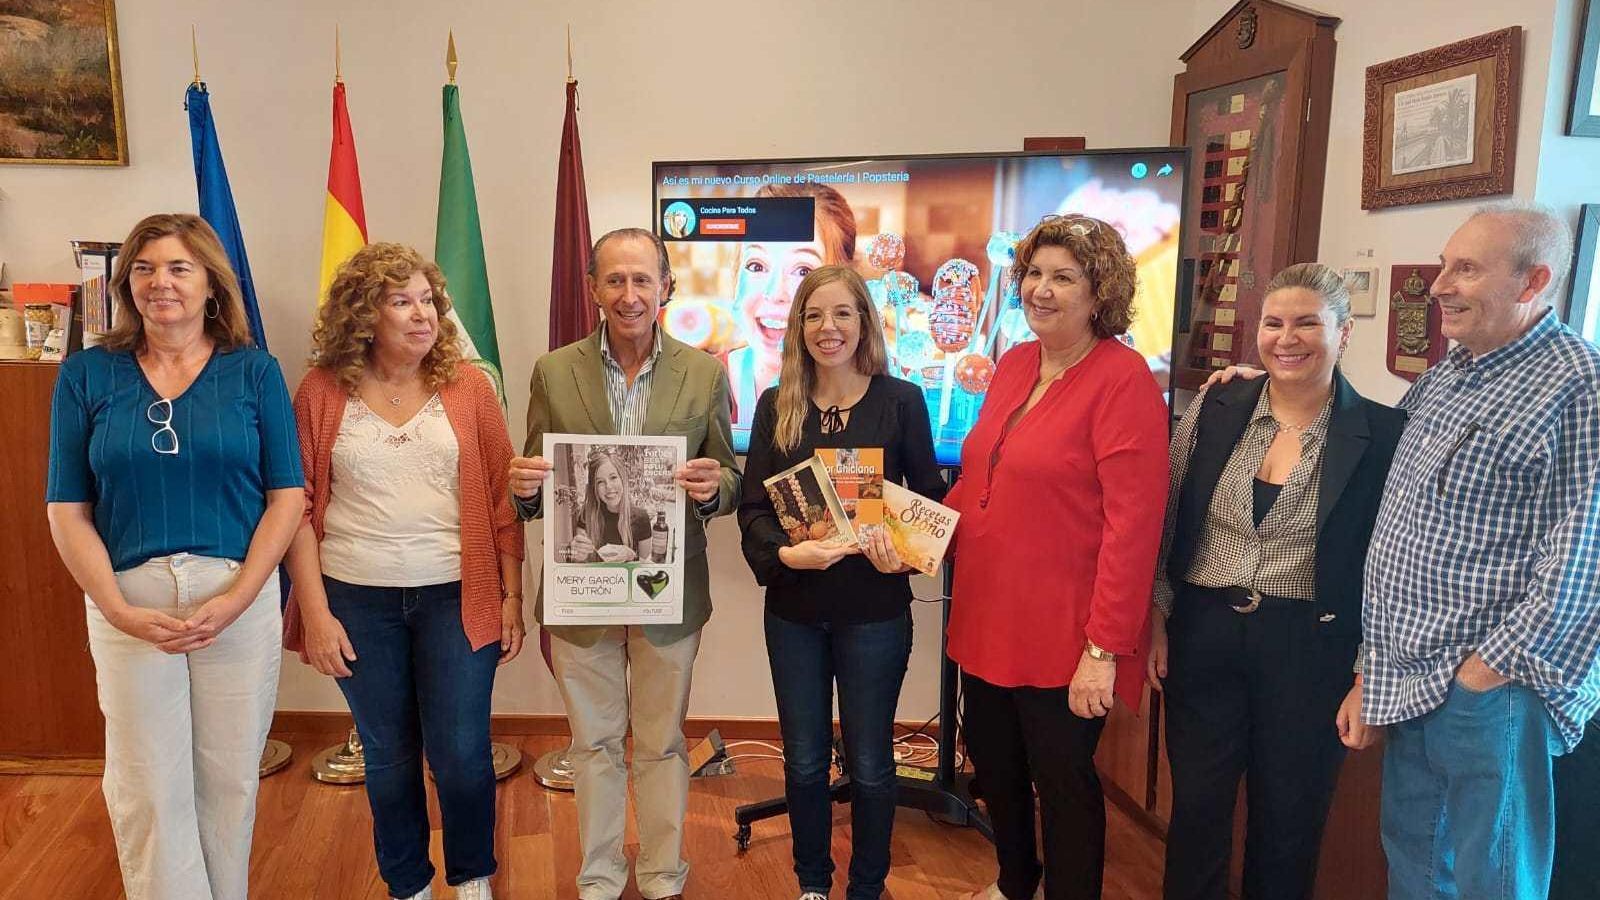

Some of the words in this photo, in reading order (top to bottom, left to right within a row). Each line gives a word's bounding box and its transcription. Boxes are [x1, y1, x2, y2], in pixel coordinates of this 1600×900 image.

[679, 177, 689, 185] es
[691, 176, 703, 184] mi
[704, 176, 731, 185] nuevo
[733, 175, 760, 184] Curso
[762, 174, 792, 184] Online
[794, 174, 805, 184] de
[738, 206, 756, 214] Todos
[911, 499, 952, 526] Recetas
[900, 508, 946, 538] Otoño
[557, 575, 585, 584] MERY
[588, 573, 625, 585] GARCÍA
[570, 585, 612, 595] BUTRÓN
